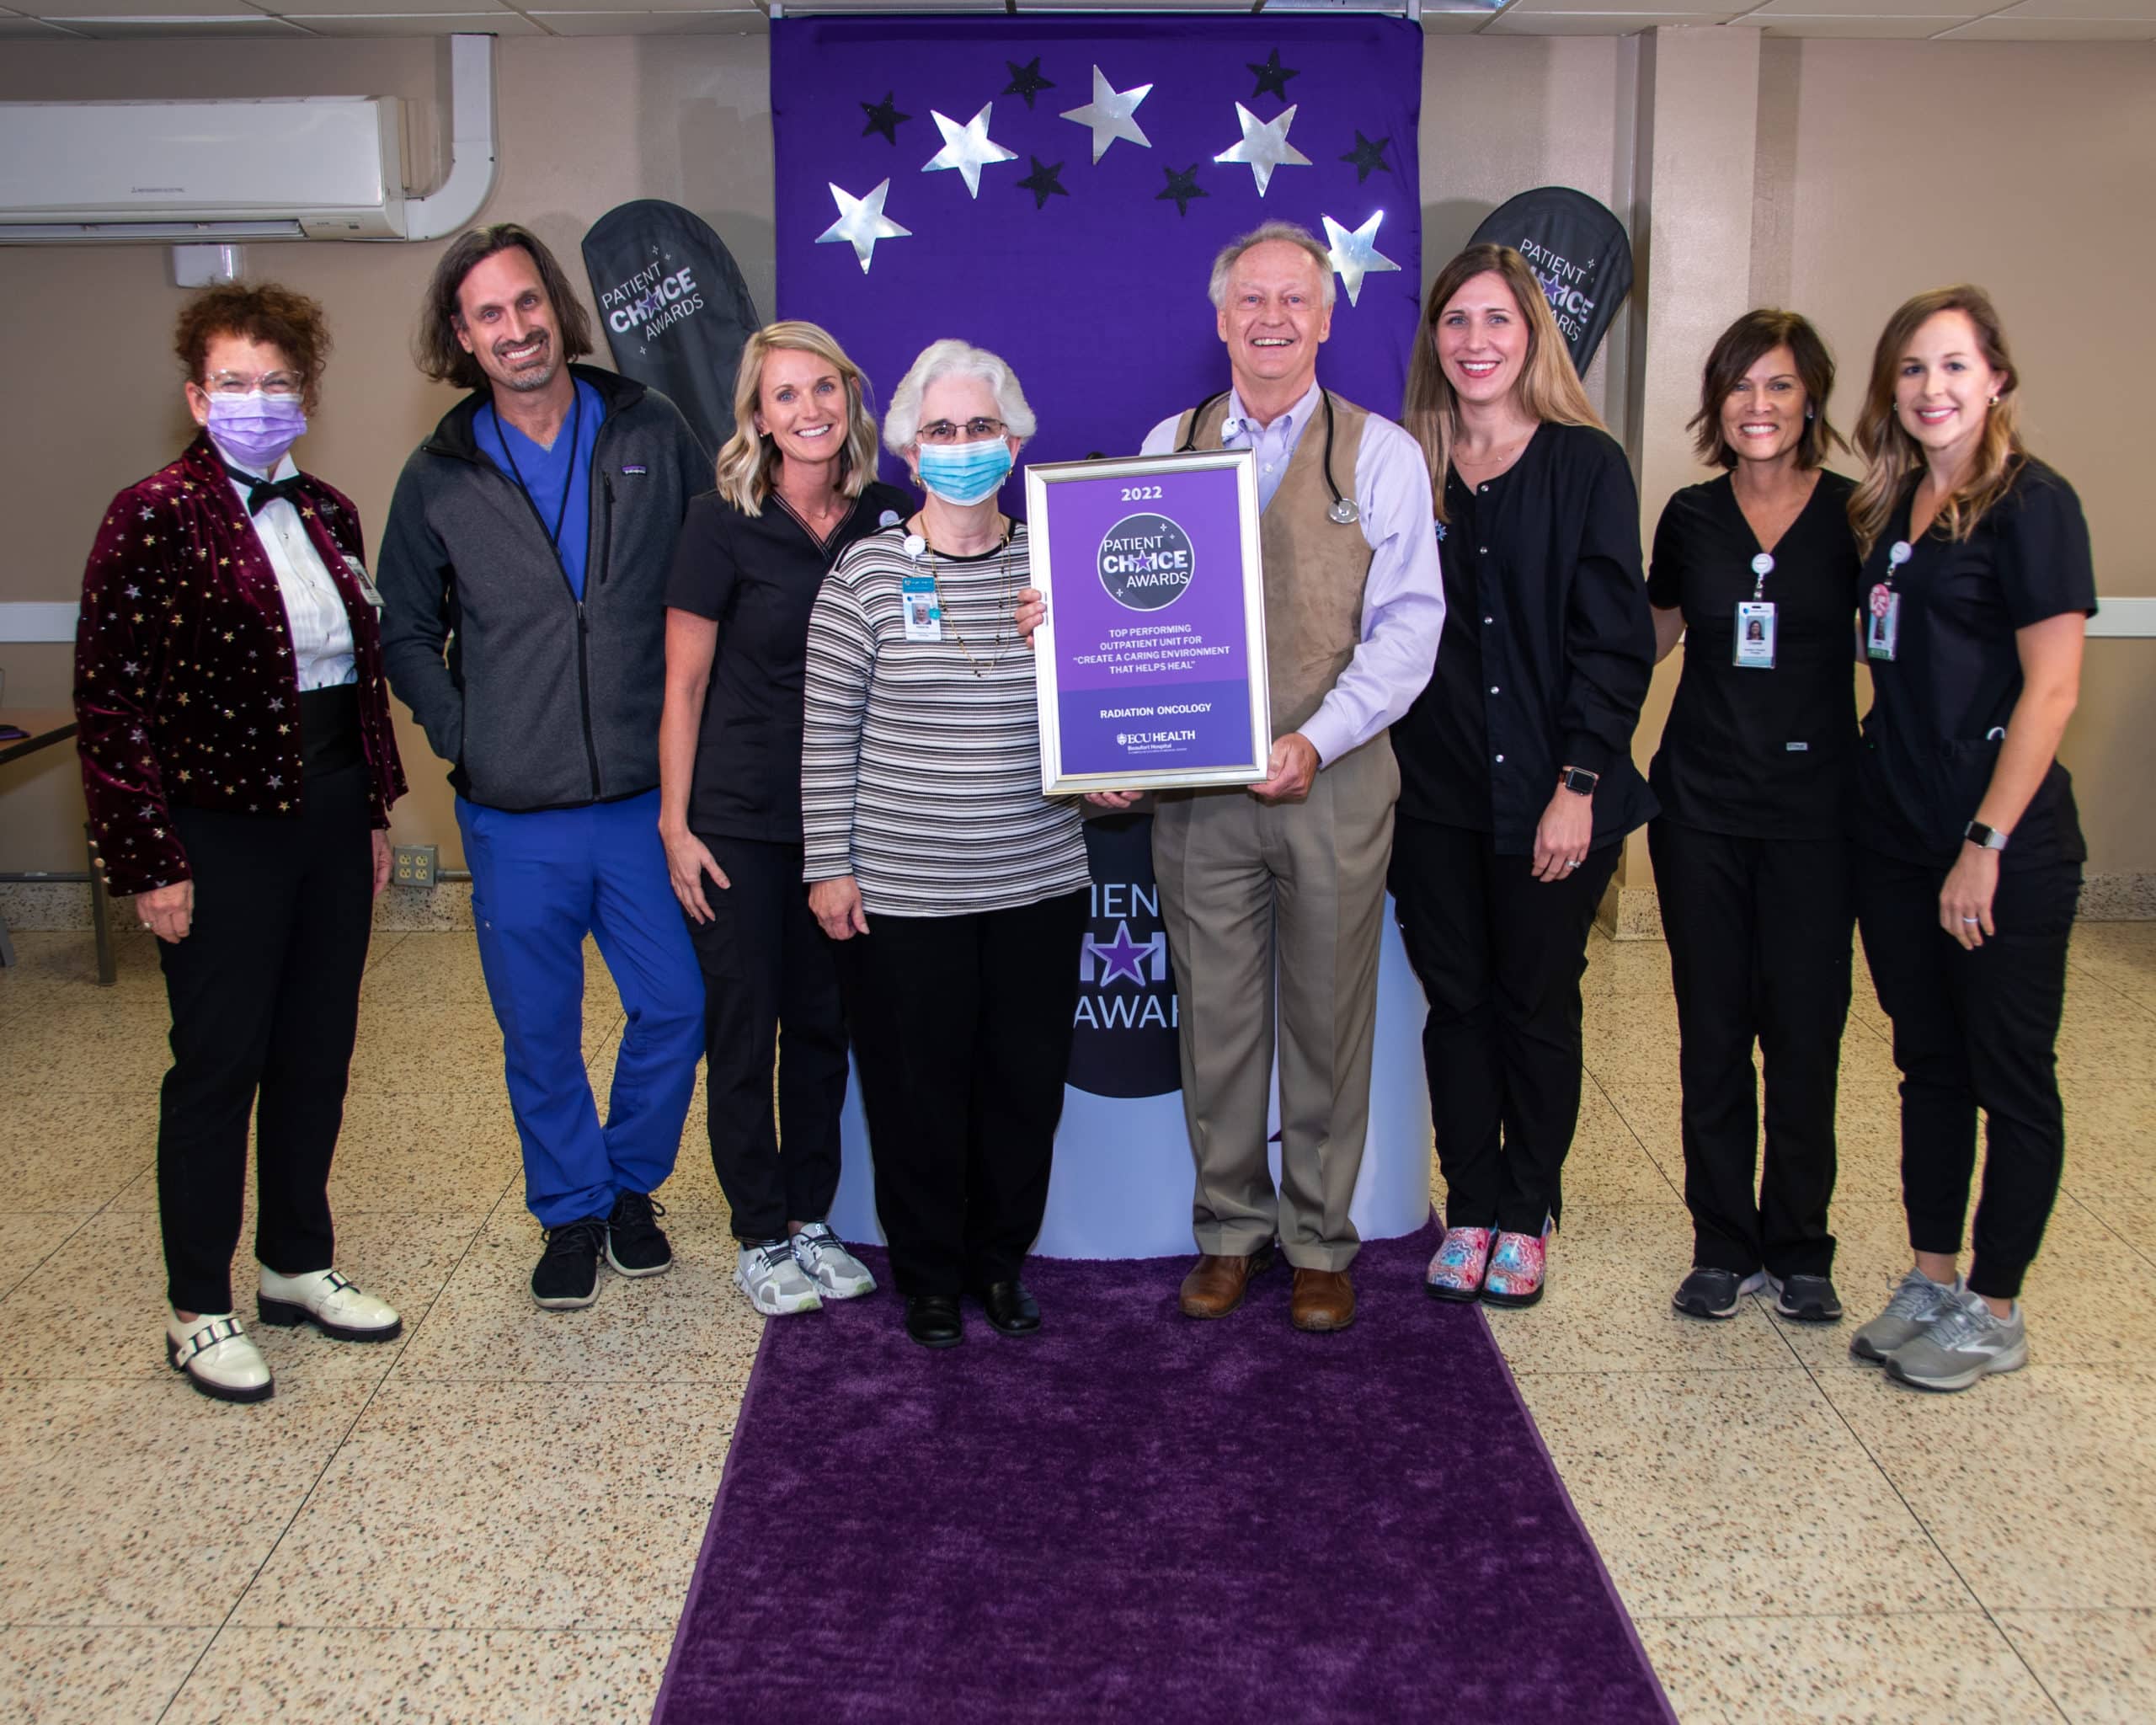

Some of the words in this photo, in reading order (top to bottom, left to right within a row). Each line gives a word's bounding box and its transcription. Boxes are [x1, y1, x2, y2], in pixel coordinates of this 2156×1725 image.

[1519, 238, 1587, 284] PATIENT
[601, 261, 661, 310] PATIENT
[645, 293, 704, 342] AWARDS
[1121, 486, 1162, 501] 2022
[1103, 536, 1163, 552] PATIENT
[1127, 572, 1188, 588] AWARDS
[1108, 629, 1129, 638] TOP
[1129, 624, 1192, 637] PERFORMING
[1100, 638, 1157, 650] OUTPATIENT
[1160, 636, 1182, 647] UNIT
[1183, 635, 1203, 644] FOR
[1115, 654, 1123, 662] A
[1123, 650, 1160, 661] CARING
[1161, 646, 1230, 659] ENVIRONMENT
[1110, 665, 1134, 674] THAT
[1135, 662, 1166, 672] HELPS
[1100, 707, 1154, 718] RADIATION
[1157, 702, 1212, 715] ONCOLOGY
[1128, 733, 1151, 745] ECU
[1152, 729, 1196, 742] HEALTH
